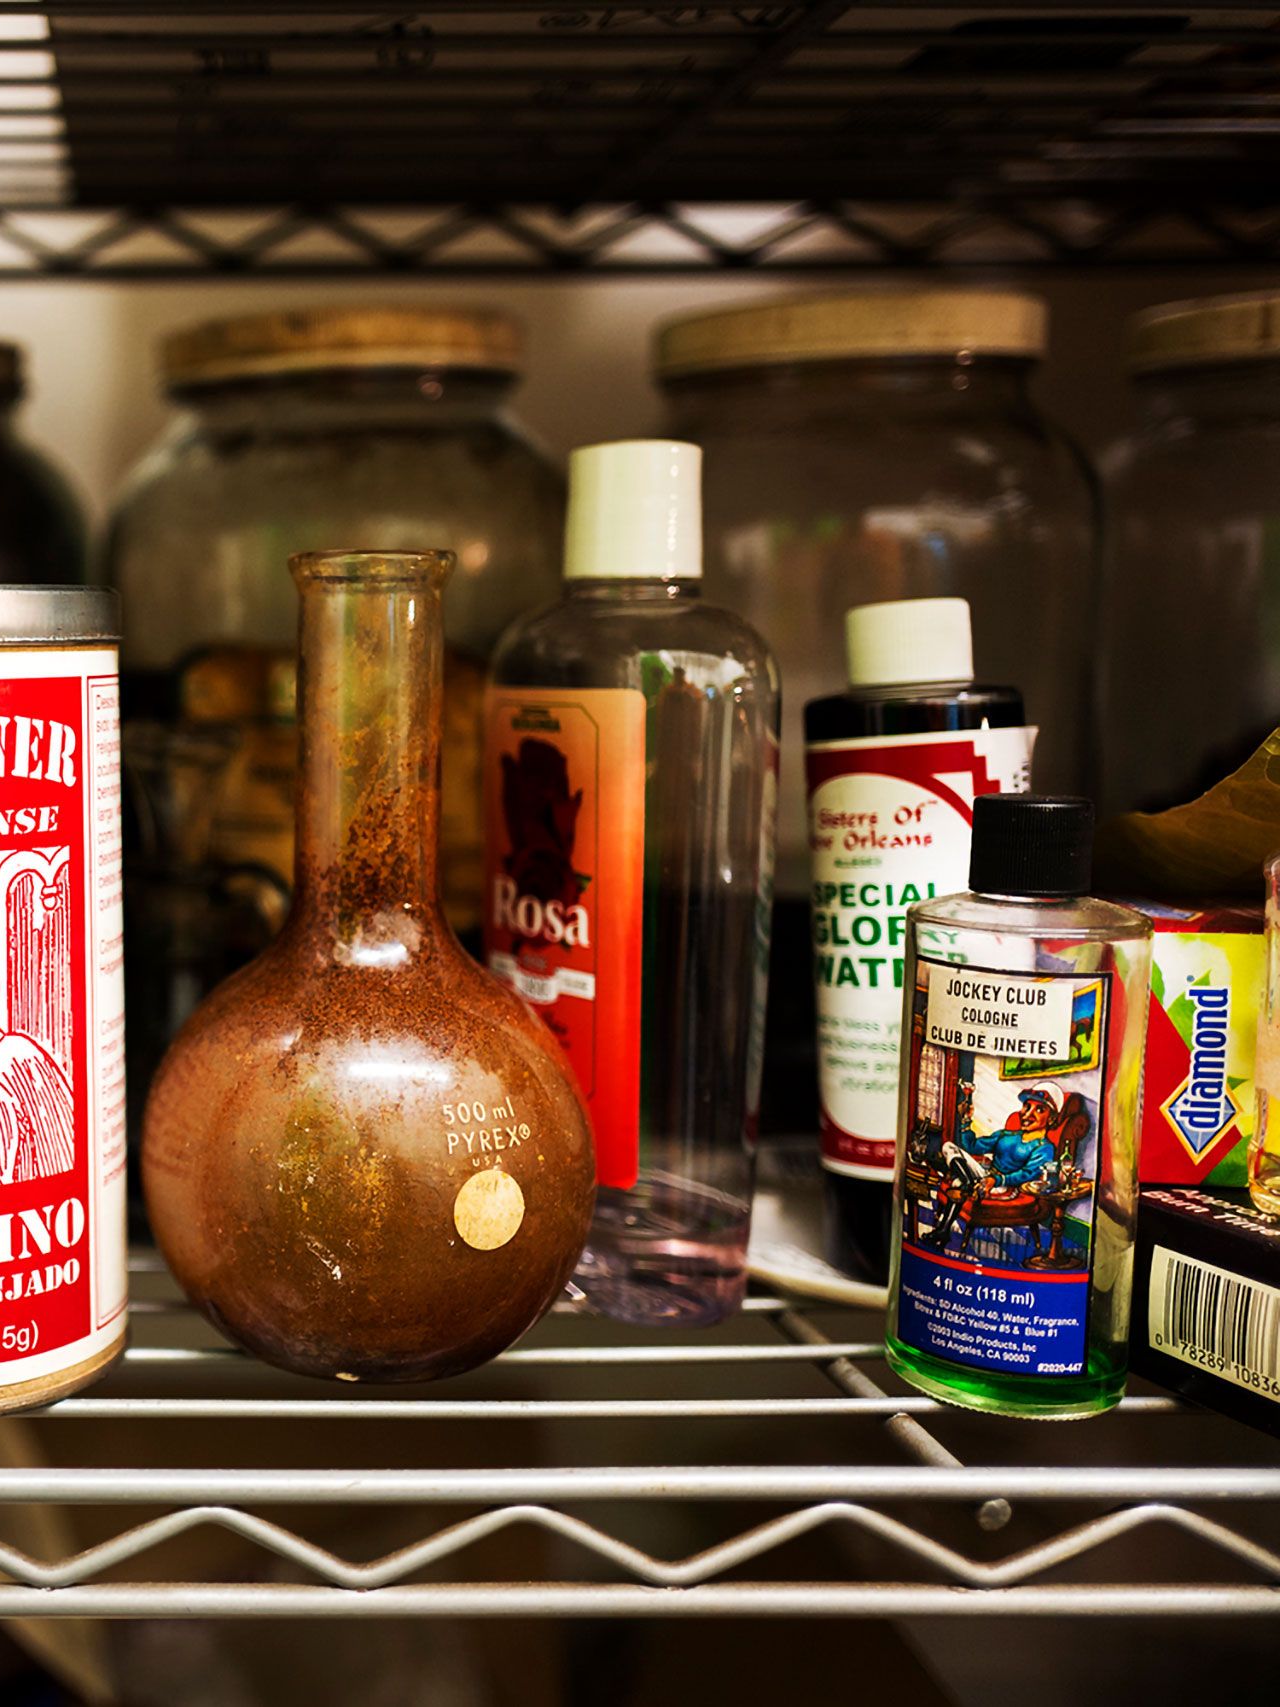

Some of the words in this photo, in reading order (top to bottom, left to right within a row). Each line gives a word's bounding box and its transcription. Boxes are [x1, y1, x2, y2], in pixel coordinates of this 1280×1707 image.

[843, 831, 933, 852] Orleans
[492, 874, 590, 949] Rosa
[946, 979, 1001, 1002] JOCKEY
[1006, 987, 1047, 1006] CLUB
[961, 1006, 1019, 1027] COLOGNE
[931, 1025, 963, 1044] CLUB
[967, 1033, 986, 1049] DE
[1180, 988, 1228, 1130] diamond
[443, 1101, 487, 1125] 500
[492, 1096, 515, 1120] ml
[933, 1275, 941, 1287] 4
[944, 1278, 953, 1291] fl
[956, 1284, 973, 1297] oz
[976, 1286, 1007, 1302] (118
[1010, 1292, 1035, 1308] ml)
[935, 1309, 941, 1318] &
[968, 1318, 997, 1331] Yellow
[1012, 1325, 1020, 1335] &
[1024, 1326, 1046, 1337] Blue
[952, 1303, 985, 1318] Alcohol
[1002, 1312, 1031, 1325] Water,
[931, 1334, 946, 1347] Los
[947, 1340, 985, 1358] Angeles,
[986, 1349, 1001, 1360] CA
[952, 1330, 975, 1343] Indio
[976, 1335, 1020, 1352] Products,
[1022, 1342, 1037, 1353] Inc
[1155, 1333, 1163, 1347] 0
[1180, 1341, 1225, 1372] 78289
[1233, 1364, 1280, 1396] 10836
